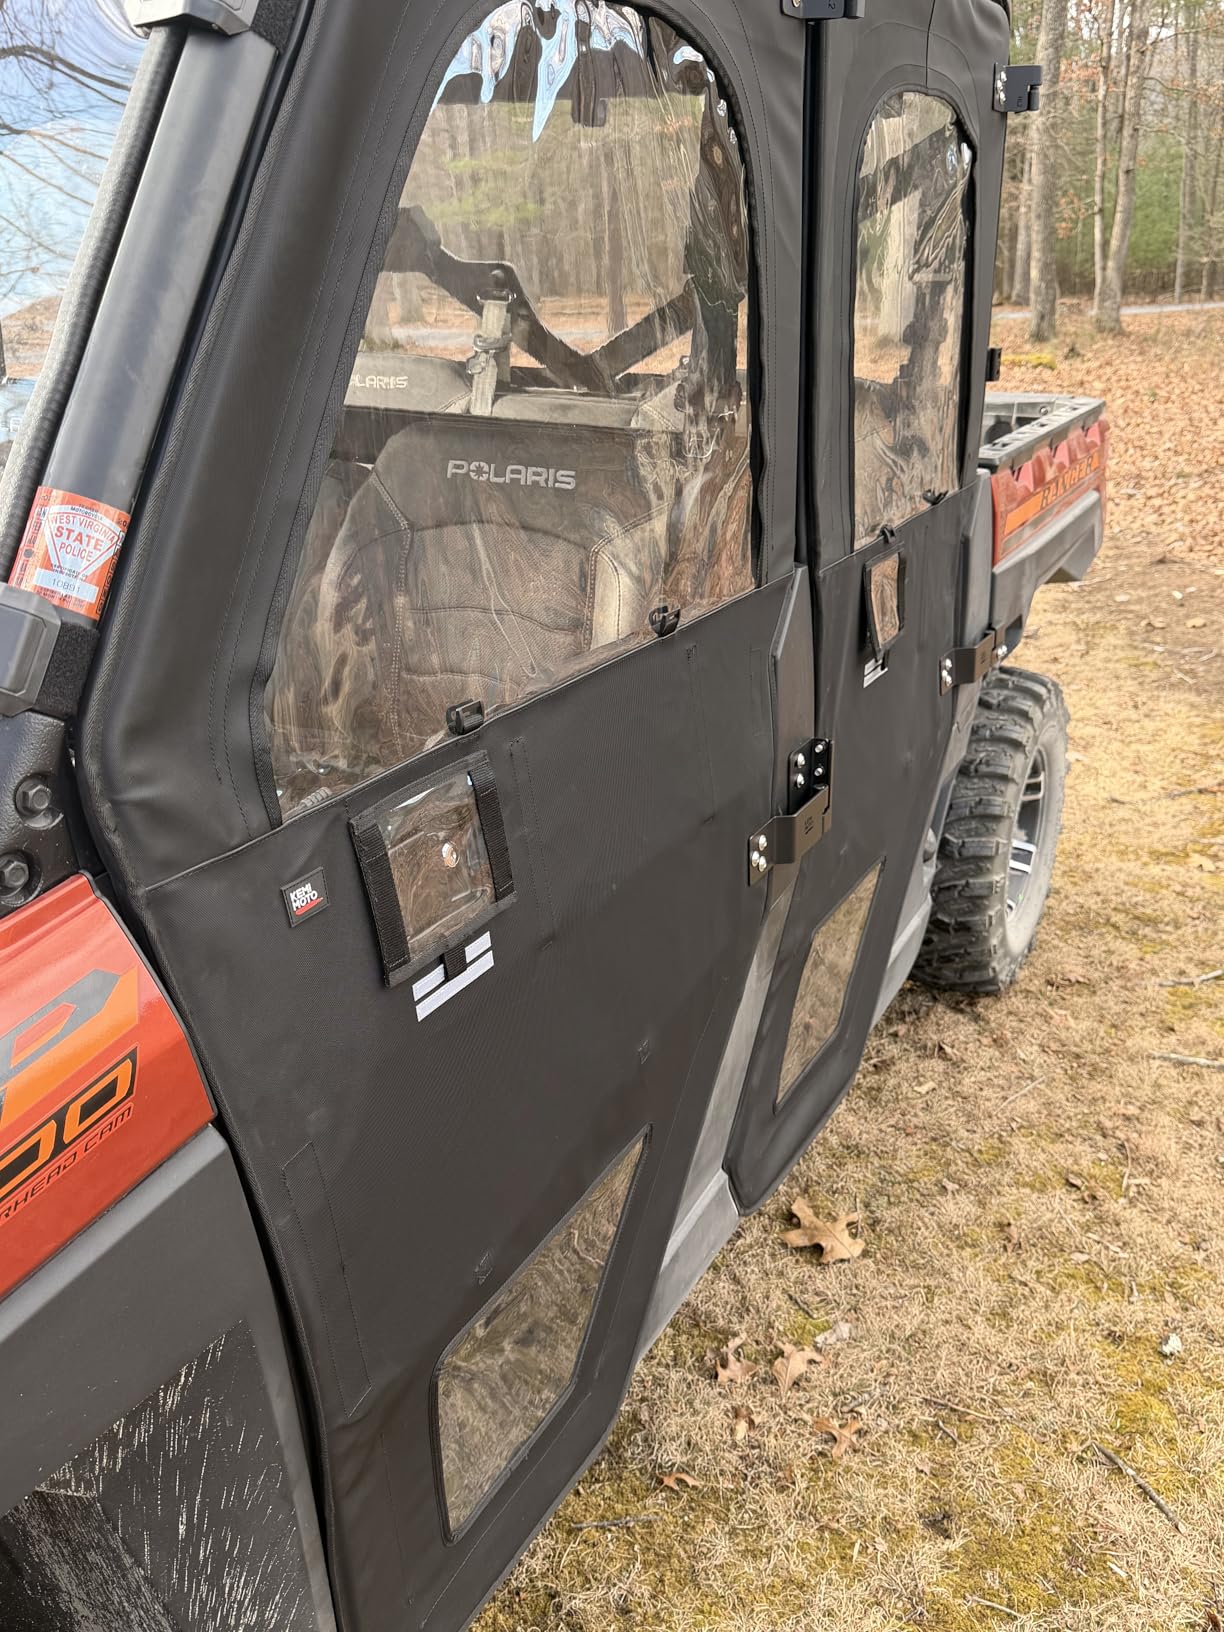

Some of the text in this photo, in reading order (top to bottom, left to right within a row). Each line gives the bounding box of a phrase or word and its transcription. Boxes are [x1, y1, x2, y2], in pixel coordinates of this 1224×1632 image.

[350, 374, 408, 390] LARIS
[446, 459, 577, 491] POLARIS
[51, 514, 76, 525] WEST
[78, 517, 116, 545] VIRGINIA
[54, 525, 104, 553] STATE
[58, 542, 94, 562] POLICE
[51, 578, 82, 594] 10891
[290, 883, 312, 900] KEMI
[292, 890, 318, 911] MOTO
[83, 1106, 132, 1153] CAM
